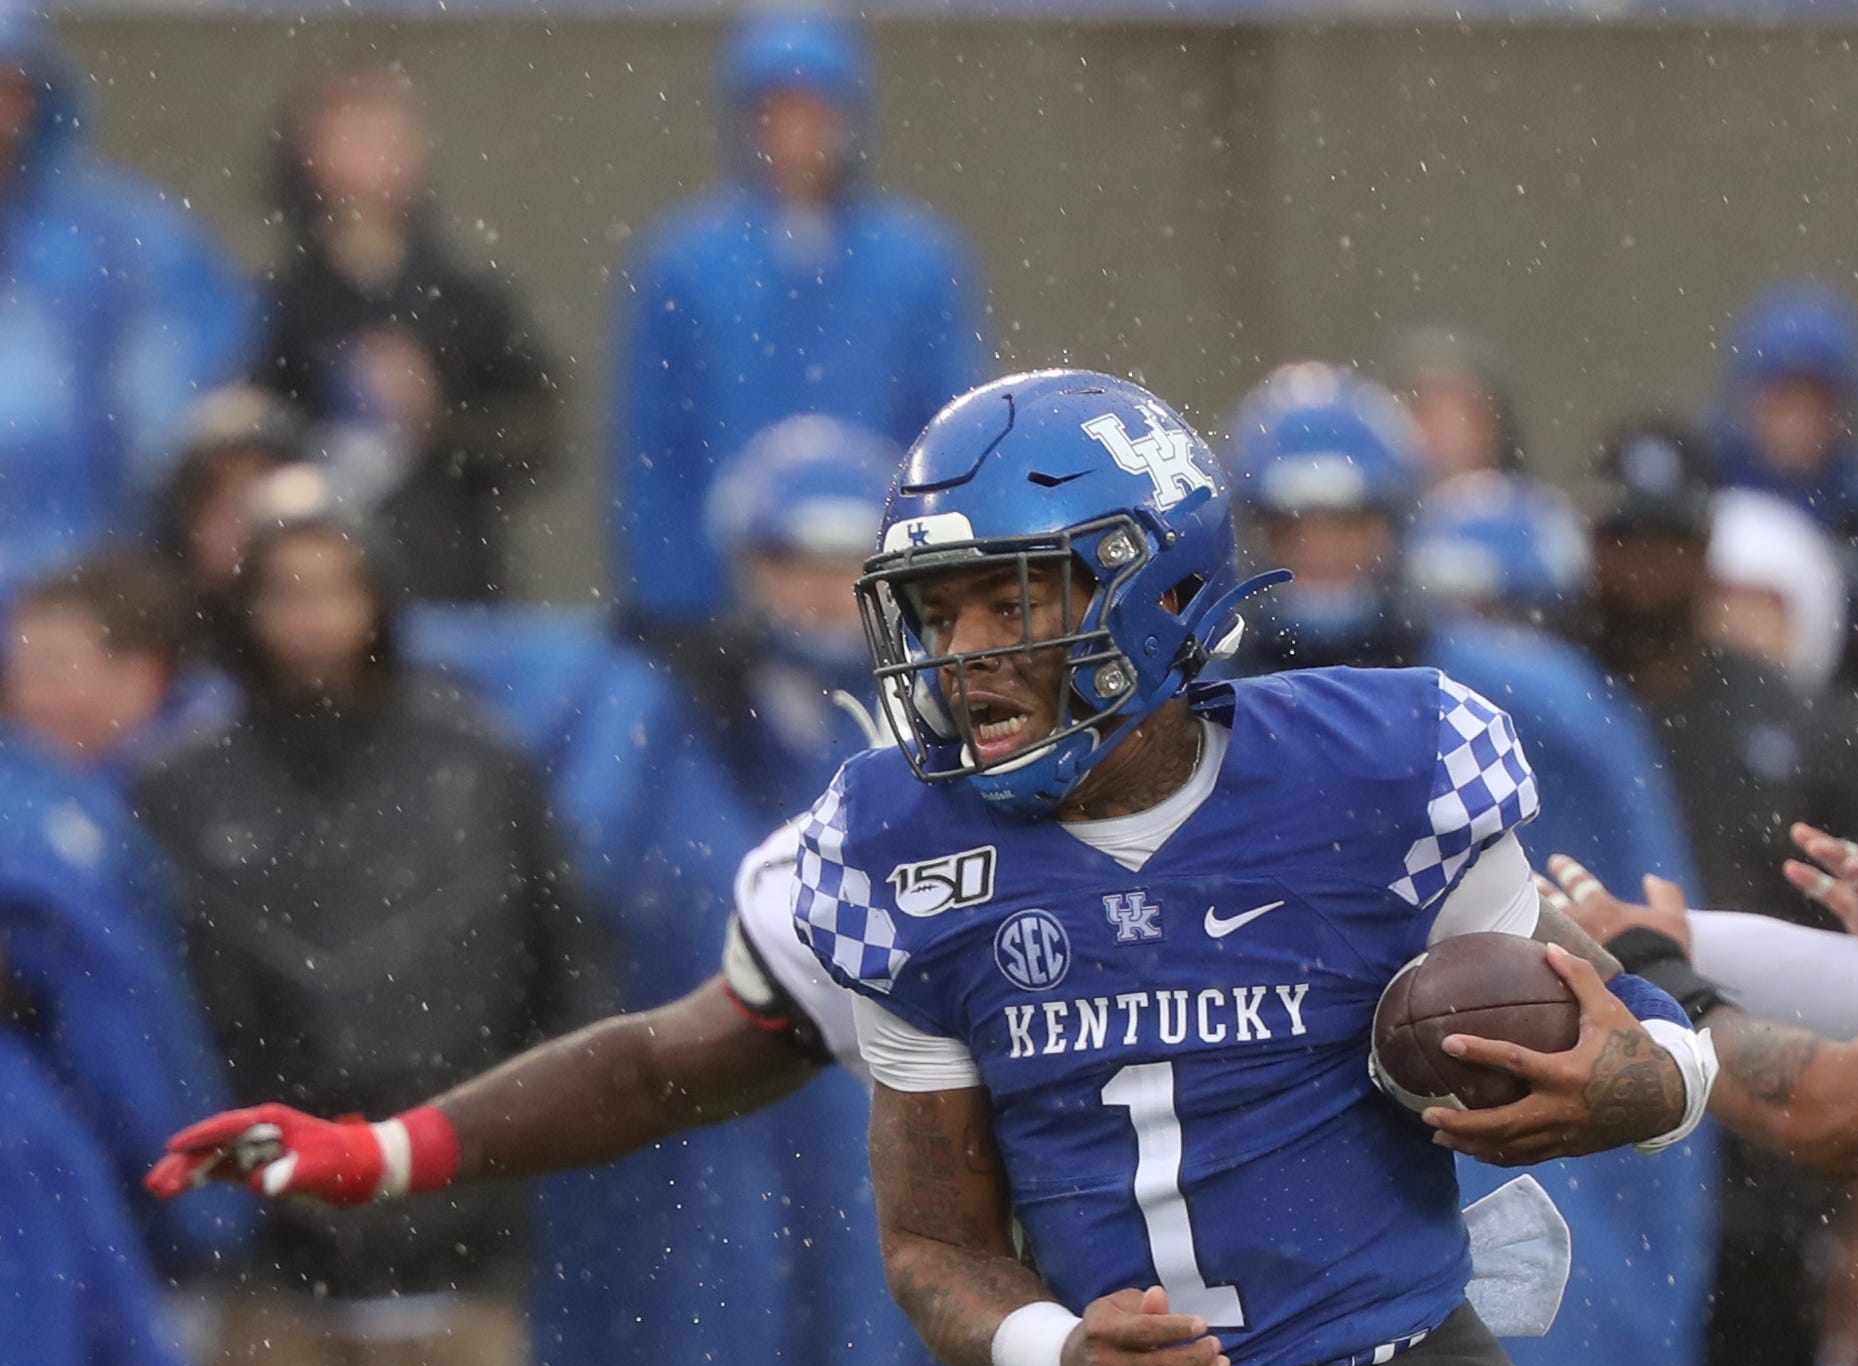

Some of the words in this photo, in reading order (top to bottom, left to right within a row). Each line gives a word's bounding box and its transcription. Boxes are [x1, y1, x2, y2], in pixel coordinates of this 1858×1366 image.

[1080, 405, 1218, 512] UK
[890, 846, 996, 911] 150
[1002, 916, 1062, 985] SEC
[1103, 891, 1162, 942] UK
[1003, 983, 1310, 1059] KENTUCKY
[1101, 1061, 1245, 1328] 1
